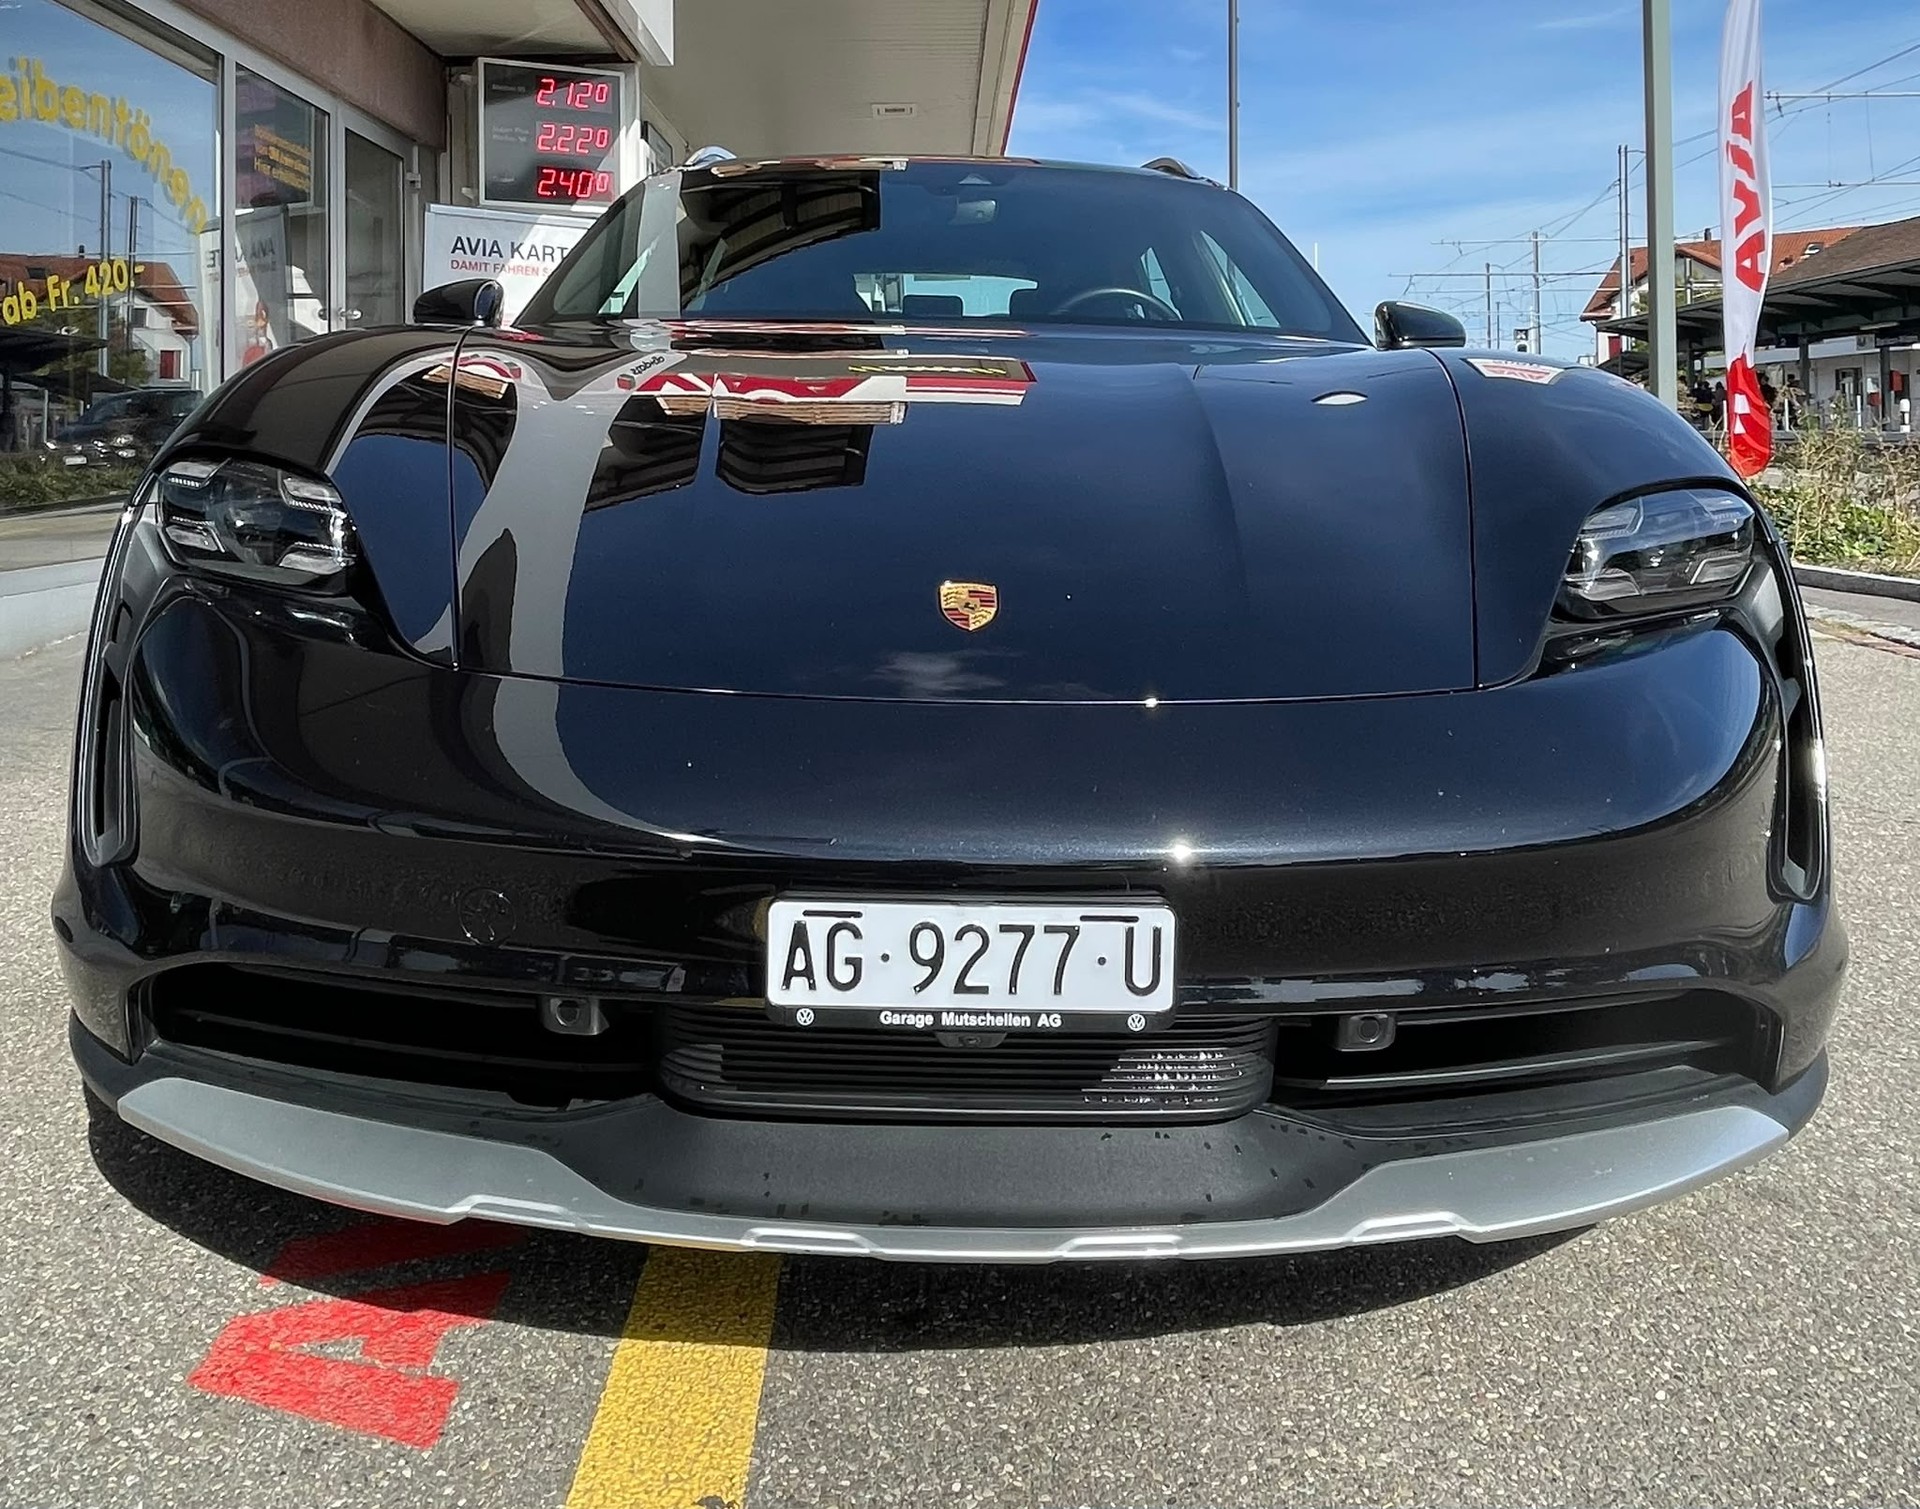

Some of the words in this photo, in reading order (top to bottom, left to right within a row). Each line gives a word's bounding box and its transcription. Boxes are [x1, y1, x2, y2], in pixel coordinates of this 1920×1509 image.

[536, 78, 609, 109] 2.120
[536, 123, 609, 154] 2.220
[536, 168, 610, 198] 2.400
[1726, 80, 1766, 293] AVIA
[450, 235, 504, 259] AVIA
[510, 241, 569, 263] KART
[450, 259, 490, 273] DAMIT
[493, 263, 539, 277] FAHREN
[2, 281, 37, 325] ab
[47, 274, 80, 312] Fr.
[879, 1010, 935, 1029] Garage
[941, 1011, 1032, 1027] Mutschellen
[1036, 1013, 1063, 1028] AG
